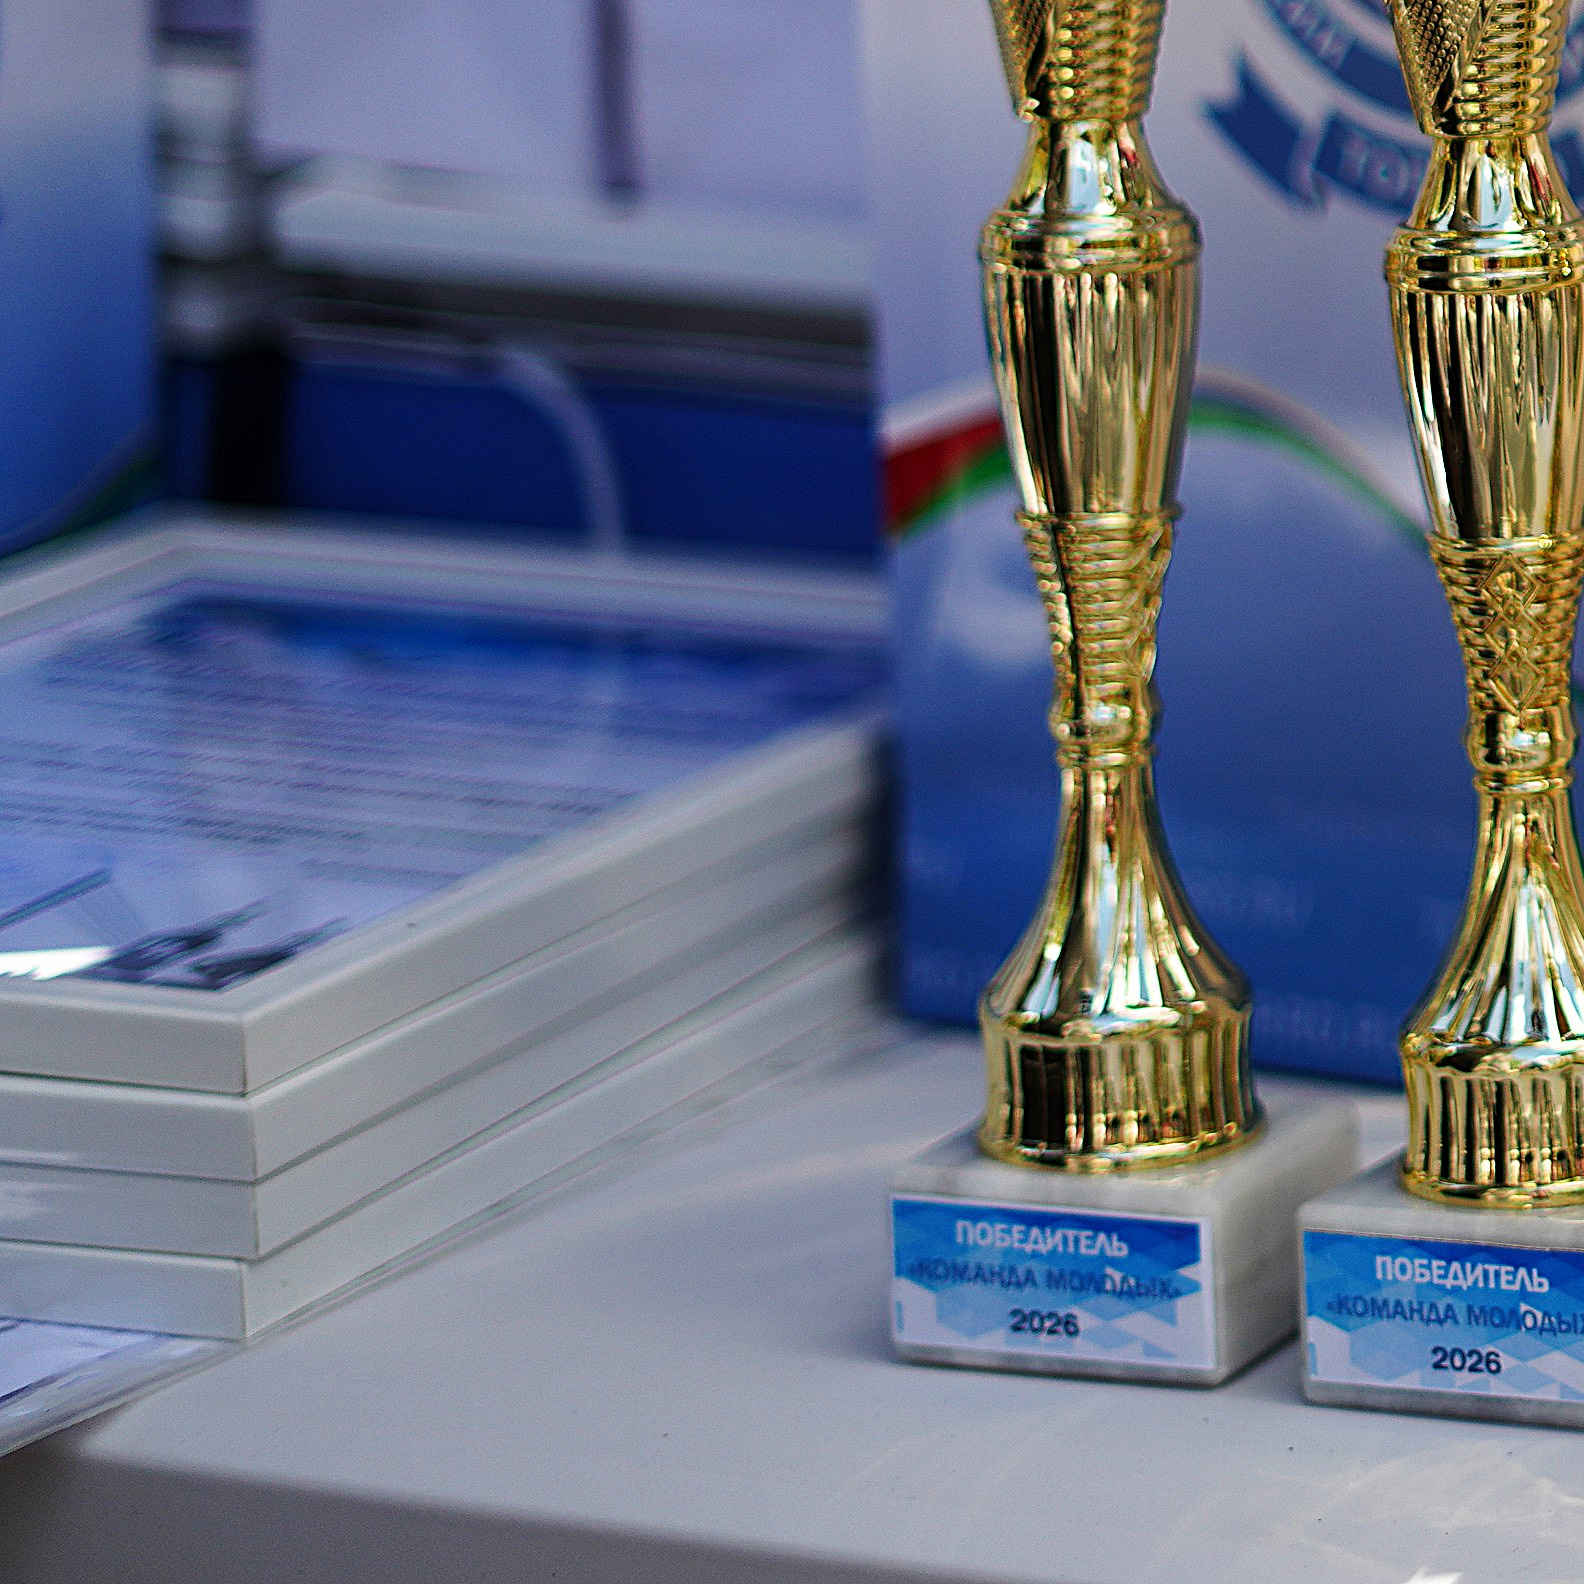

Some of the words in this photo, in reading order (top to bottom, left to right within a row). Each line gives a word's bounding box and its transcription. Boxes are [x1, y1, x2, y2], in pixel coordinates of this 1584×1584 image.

[955, 1220, 1129, 1257] ПОБЕДИТЕЛЬ
[1375, 1255, 1550, 1293] ПОБЕДИТЕЛЬ
[1009, 1308, 1080, 1337] 2026
[1326, 1294, 1459, 1327] «КОМАНДА
[1431, 1346, 1502, 1374] 2026
